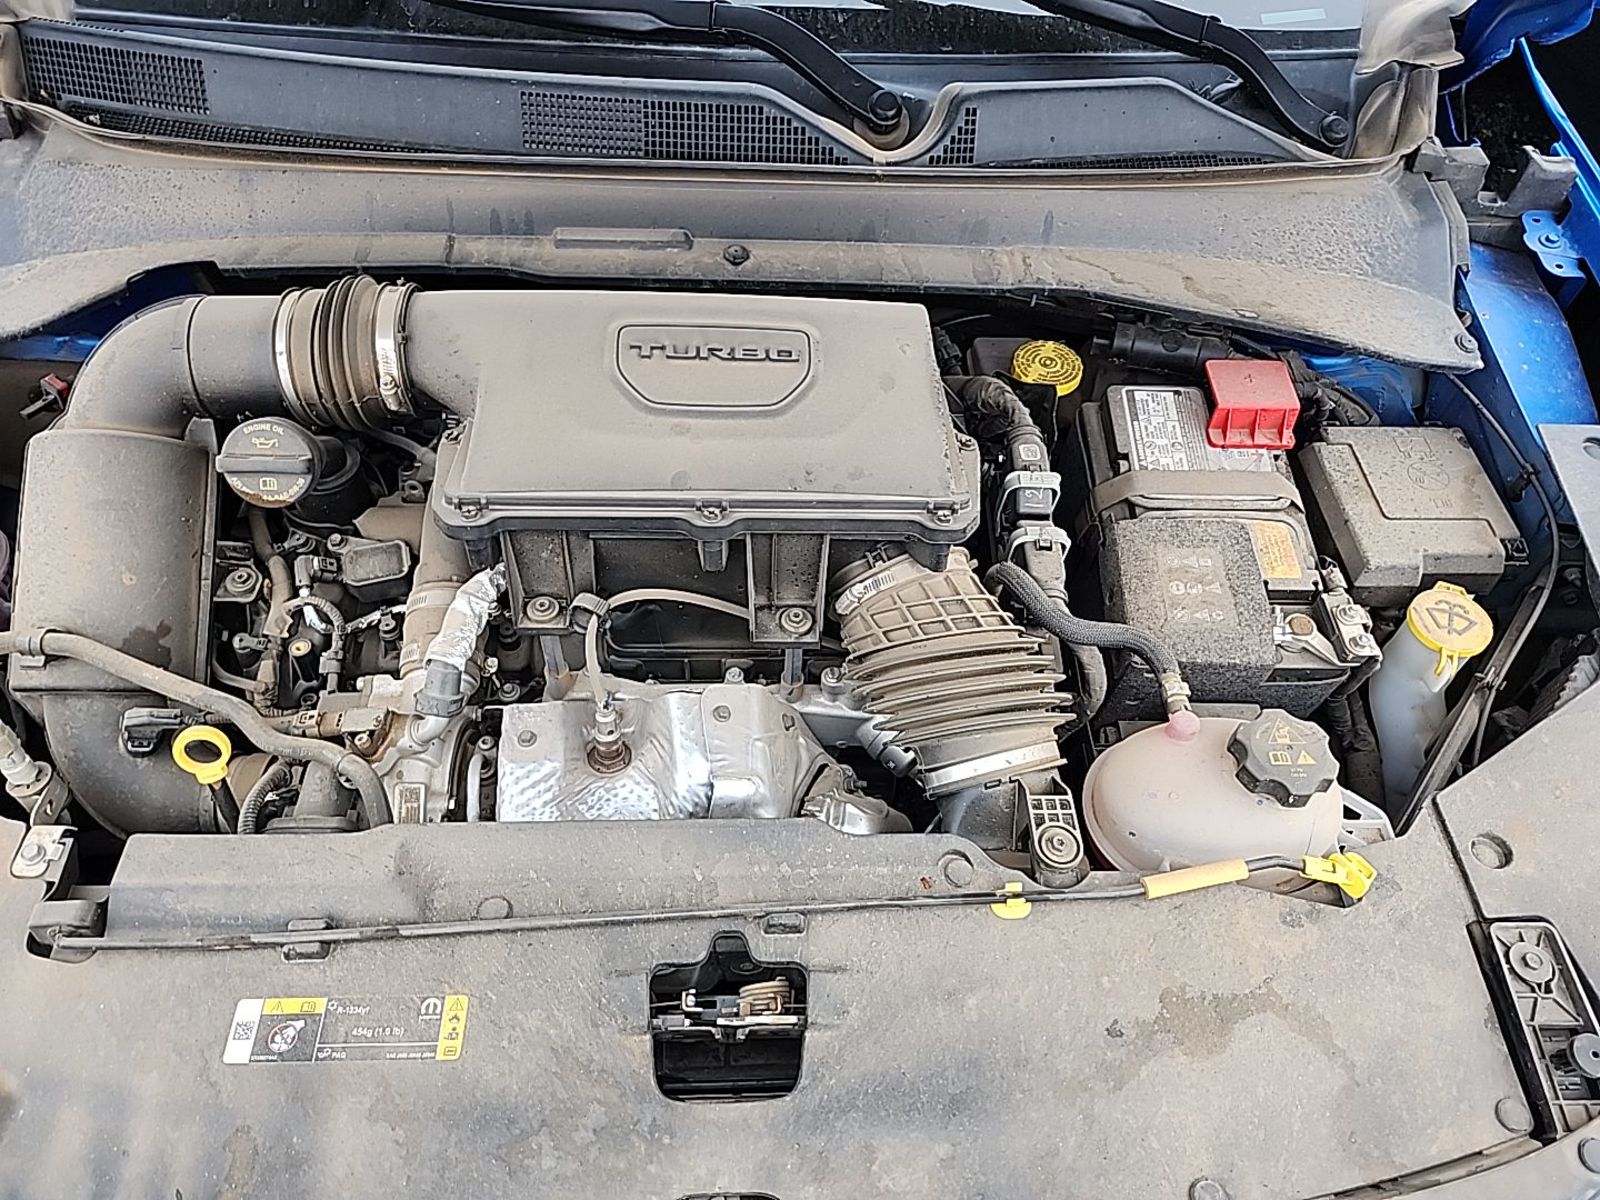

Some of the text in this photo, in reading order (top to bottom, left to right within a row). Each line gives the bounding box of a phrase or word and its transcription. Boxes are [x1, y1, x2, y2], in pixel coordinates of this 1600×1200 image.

[629, 344, 800, 362] TURBO
[243, 423, 284, 435] ENGINE OIL
[352, 1027, 373, 1038] 454g
